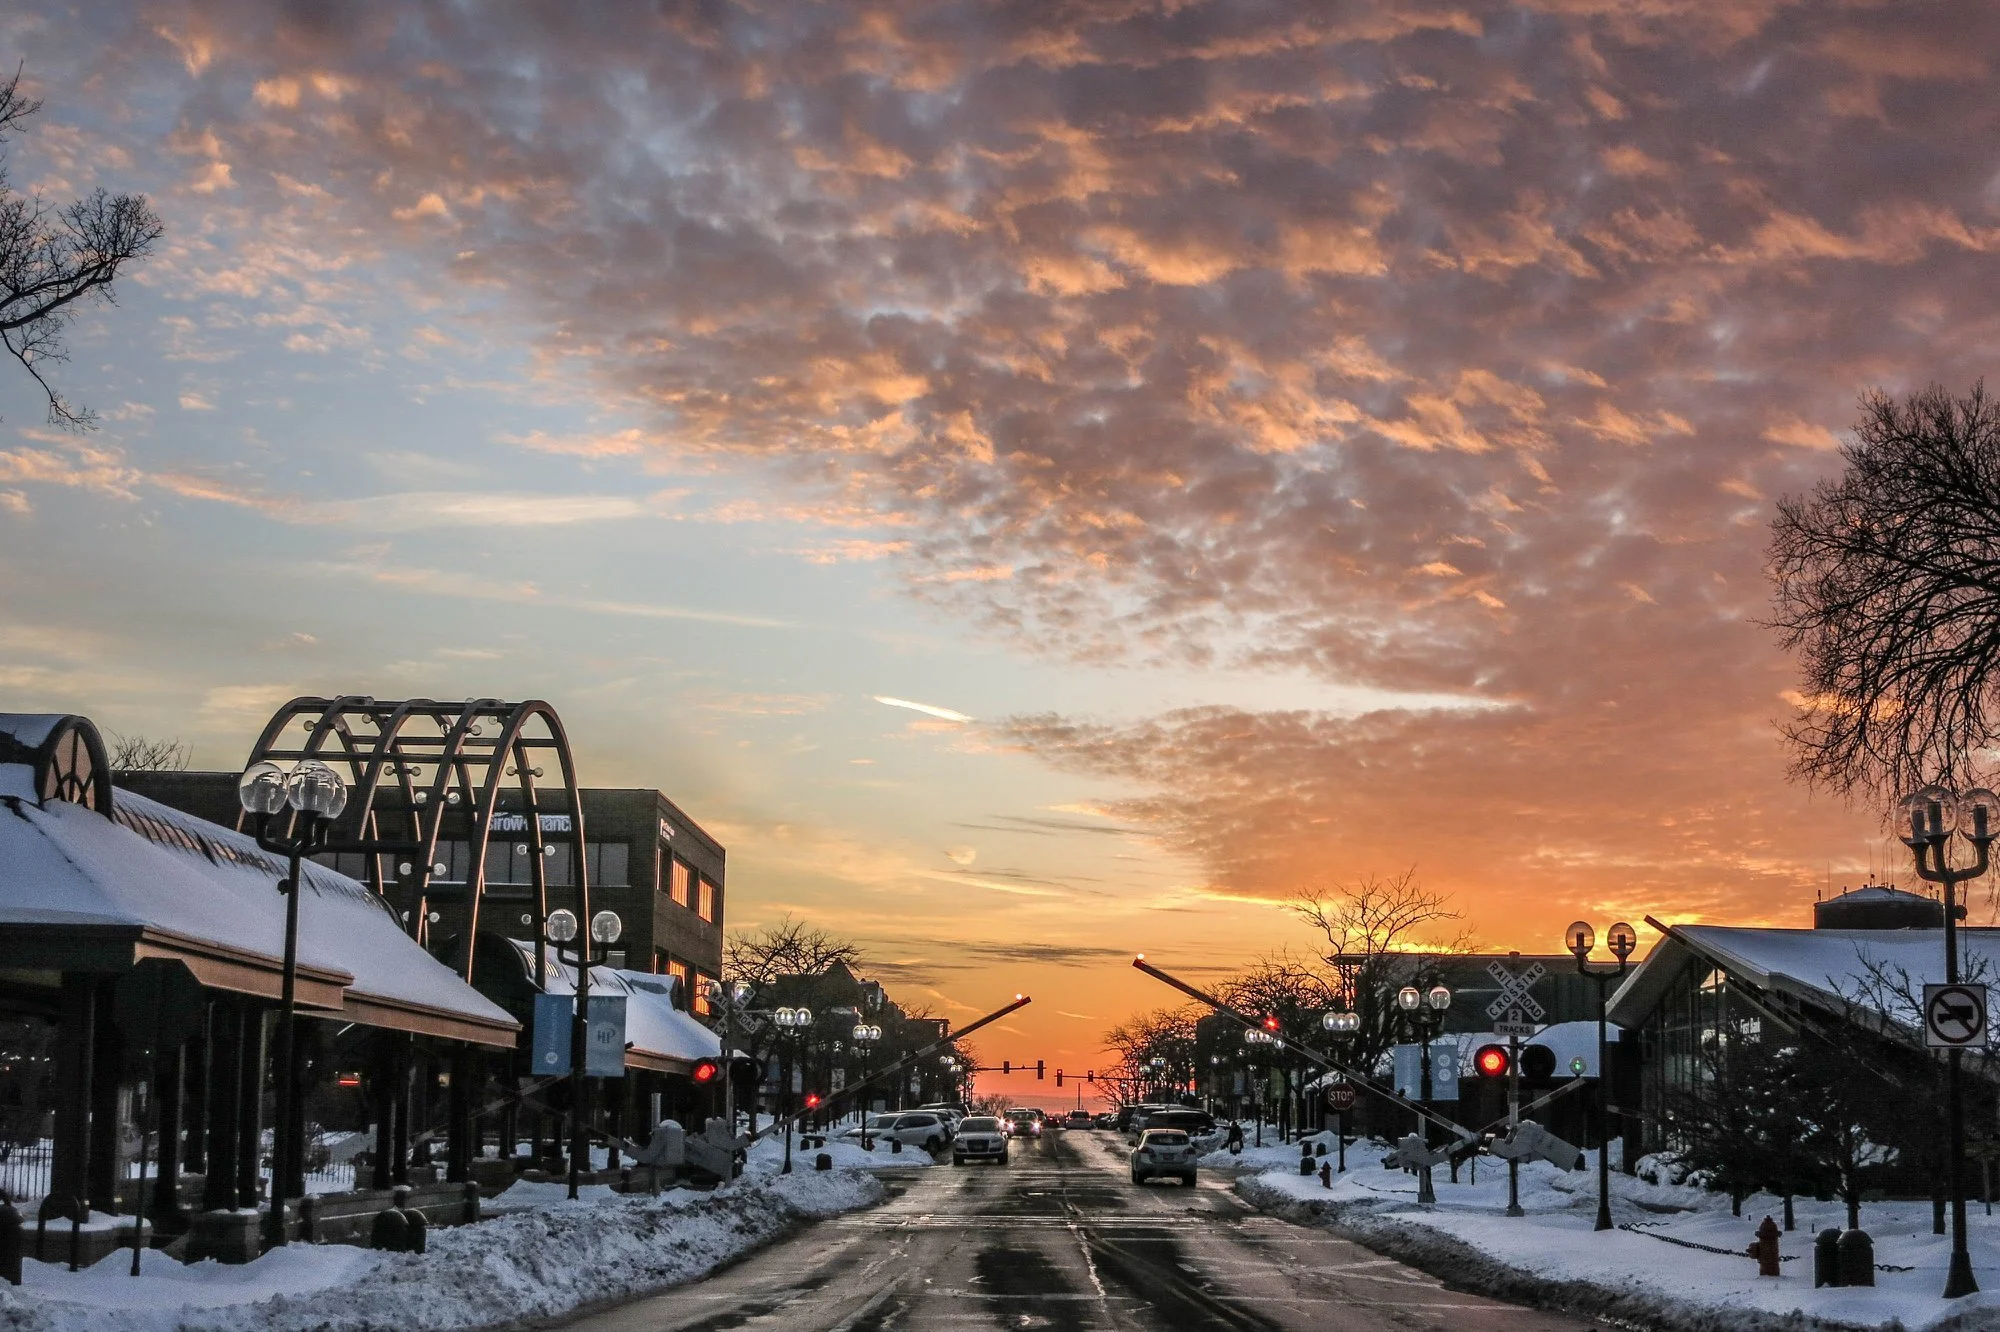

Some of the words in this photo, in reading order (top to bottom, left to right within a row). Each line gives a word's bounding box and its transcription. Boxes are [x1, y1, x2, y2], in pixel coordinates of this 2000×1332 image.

[1488, 962, 1543, 1018] RAILROAD
[1489, 964, 1544, 1017] CROSSING
[712, 991, 756, 1033] RAIROAD
[1511, 1010, 1519, 1021] 2
[1500, 1025, 1531, 1034] TRACKS
[1330, 1090, 1354, 1101] STOP
